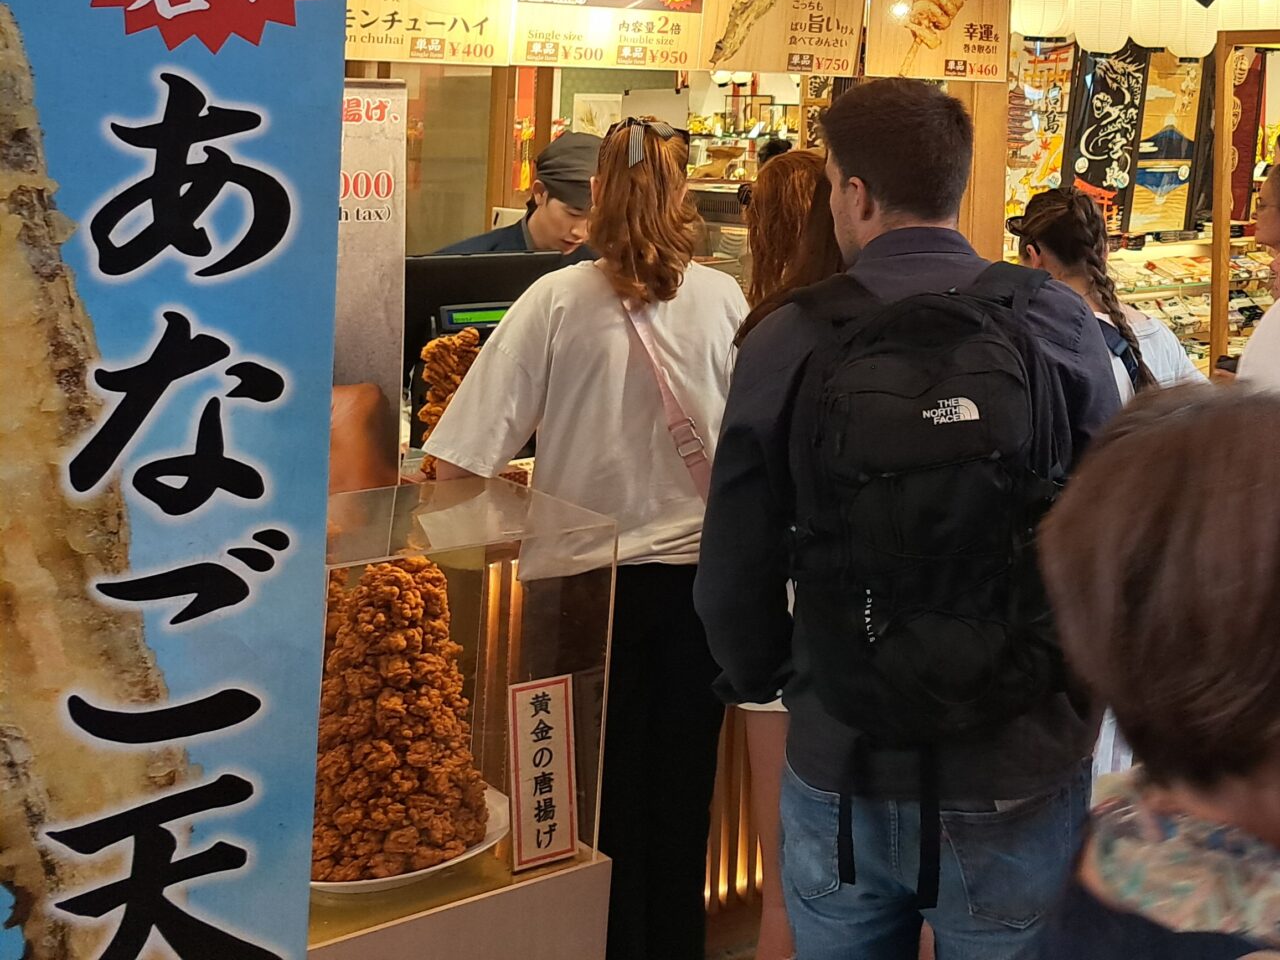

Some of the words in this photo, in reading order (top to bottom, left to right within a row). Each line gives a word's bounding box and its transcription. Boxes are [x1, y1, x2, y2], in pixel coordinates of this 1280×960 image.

[792, 0, 823, 11] こっちも
[618, 16, 682, 35] 内容量2倍
[360, 32, 405, 45] chuhai
[528, 29, 561, 42] Single
[563, 31, 583, 41] size
[789, 35, 848, 48] 食べてみんさい
[449, 42, 494, 58] ¥400
[561, 45, 604, 61] ¥500
[649, 49, 688, 65] ¥950
[815, 57, 849, 71] ¥750
[968, 62, 998, 76] ¥460
[356, 206, 391, 222] tax)
[937, 398, 960, 408] THE
[922, 406, 959, 419] NORTH
[934, 413, 960, 425] FACE
[529, 691, 557, 849] 黄金の唐揚げ
